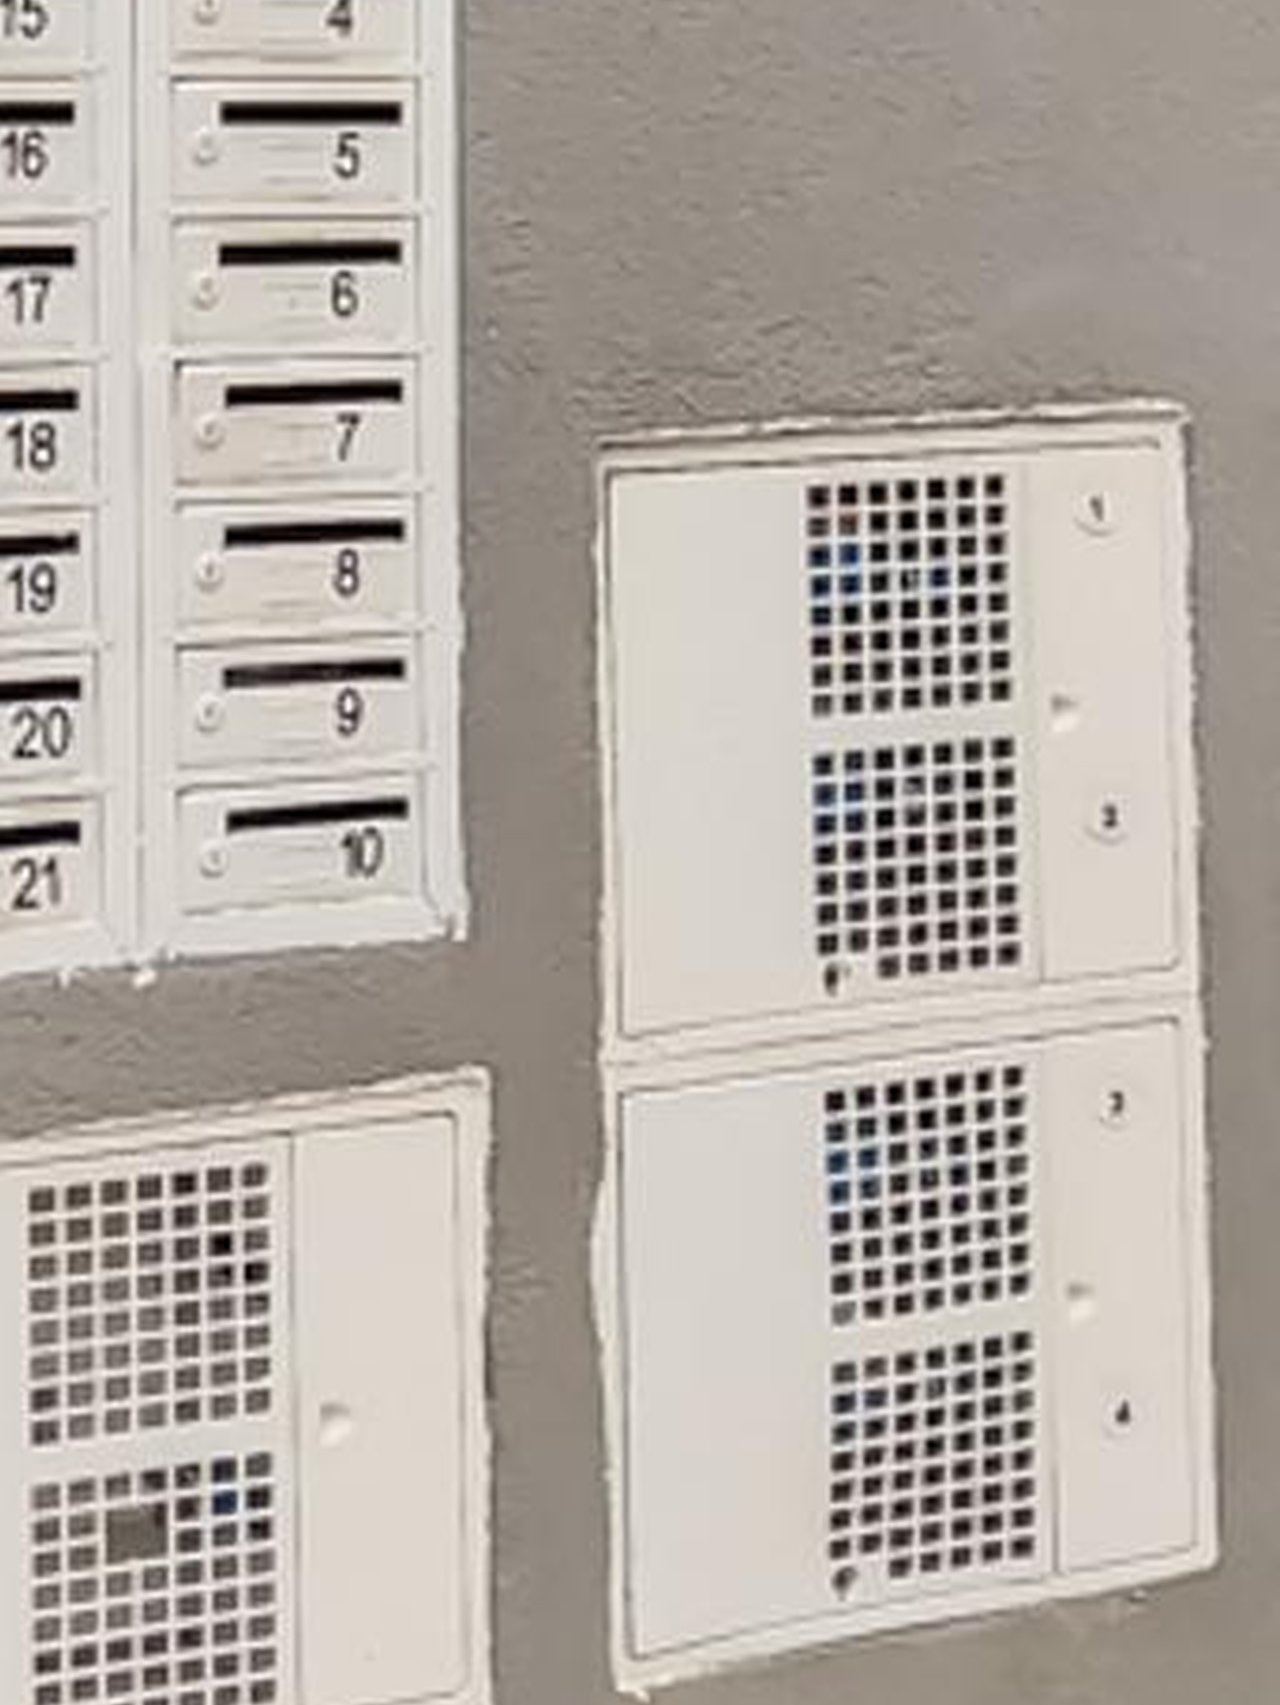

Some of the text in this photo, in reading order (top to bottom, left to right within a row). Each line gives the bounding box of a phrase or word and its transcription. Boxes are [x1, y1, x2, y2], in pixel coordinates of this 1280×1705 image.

[1, 130, 46, 179] 16
[335, 131, 360, 179] 5
[7, 274, 52, 322] 17
[331, 270, 358, 318] 6
[6, 421, 56, 472] 18
[338, 412, 361, 461] 7
[7, 562, 57, 614] 19
[333, 548, 360, 597] 8
[11, 707, 72, 760] 20
[336, 687, 363, 737] 9
[341, 827, 384, 877] 10
[12, 857, 59, 910] 21
